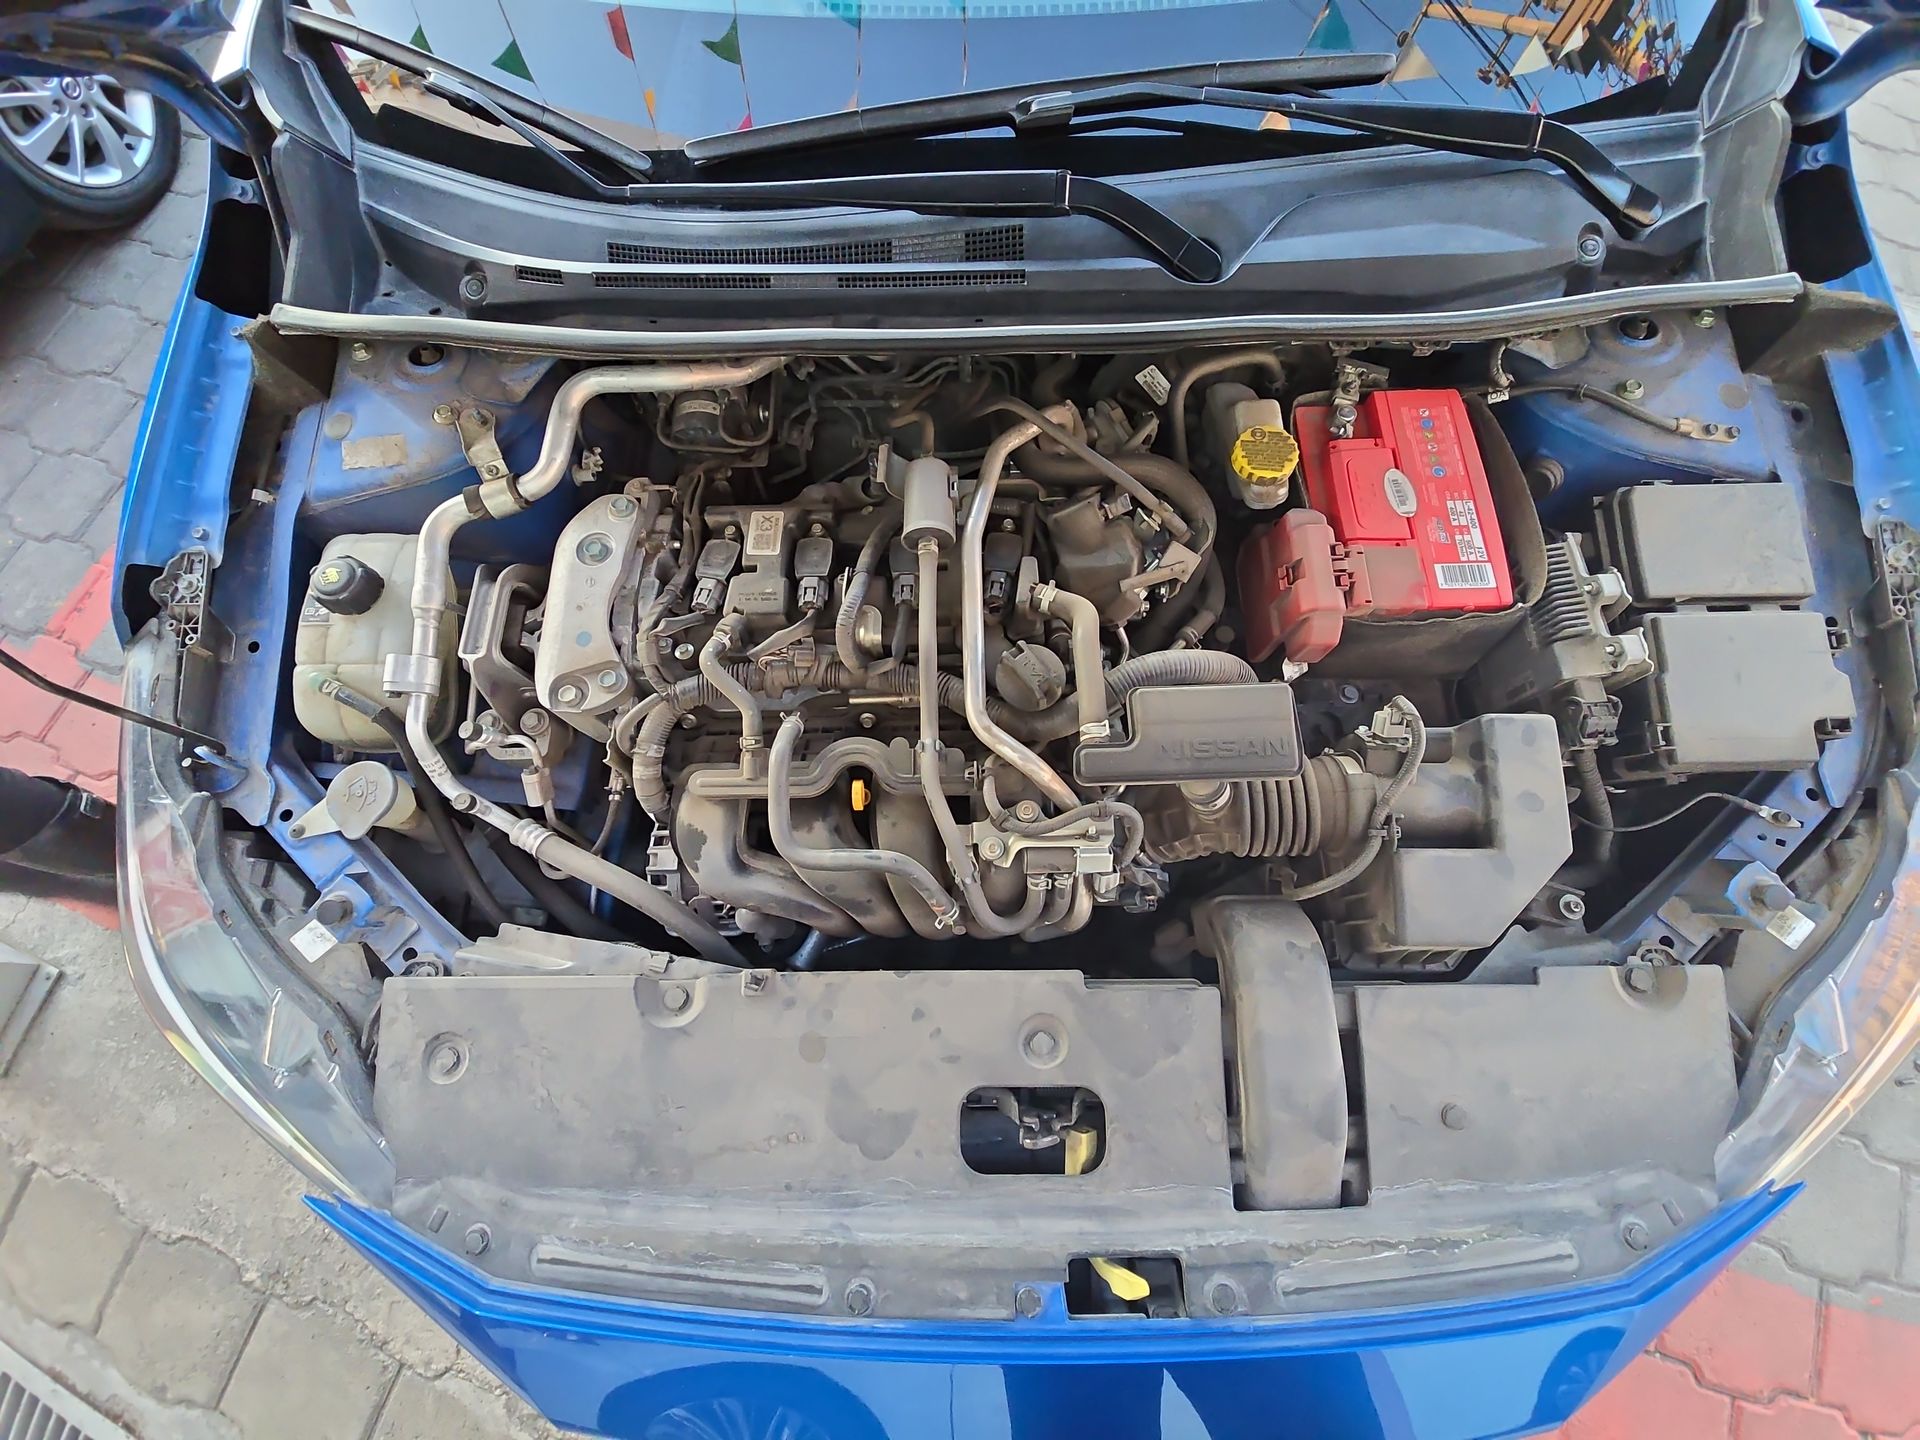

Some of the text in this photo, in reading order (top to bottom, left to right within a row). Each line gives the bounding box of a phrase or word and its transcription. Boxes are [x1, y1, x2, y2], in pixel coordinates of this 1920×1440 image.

[760, 515, 775, 531] X3
[1465, 501, 1478, 529] L-42-400
[1475, 546, 1486, 559] 12V
[1159, 737, 1288, 760] NISSAN
